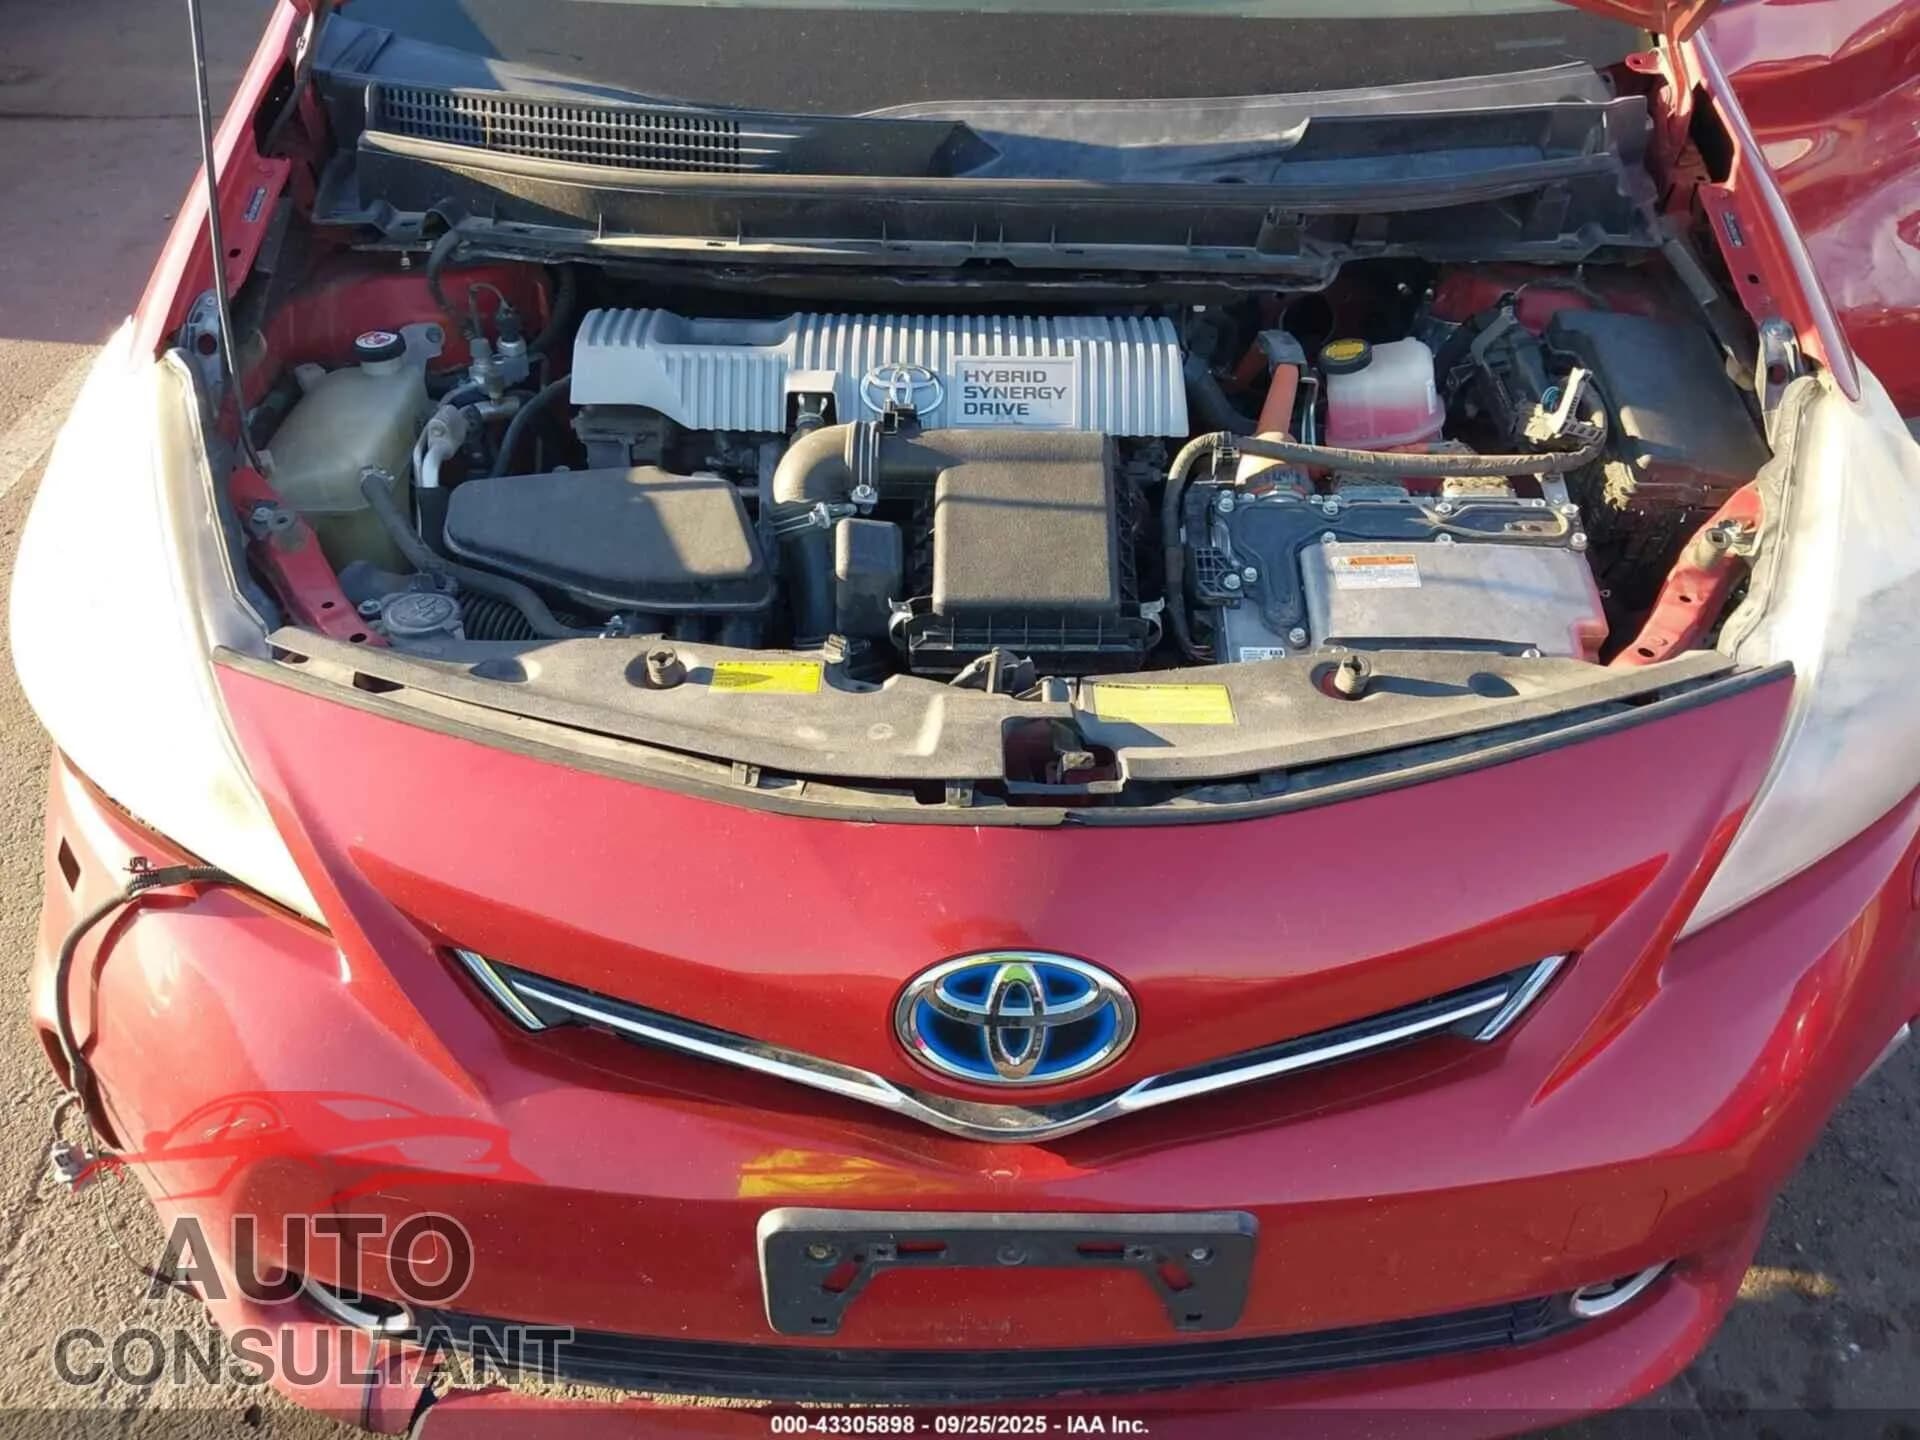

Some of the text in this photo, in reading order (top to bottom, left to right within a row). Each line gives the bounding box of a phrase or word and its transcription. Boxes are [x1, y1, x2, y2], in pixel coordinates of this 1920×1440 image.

[963, 370, 1047, 383] HYBRID
[963, 386, 1067, 400] SYNERGY
[963, 403, 1030, 416] DRIVE
